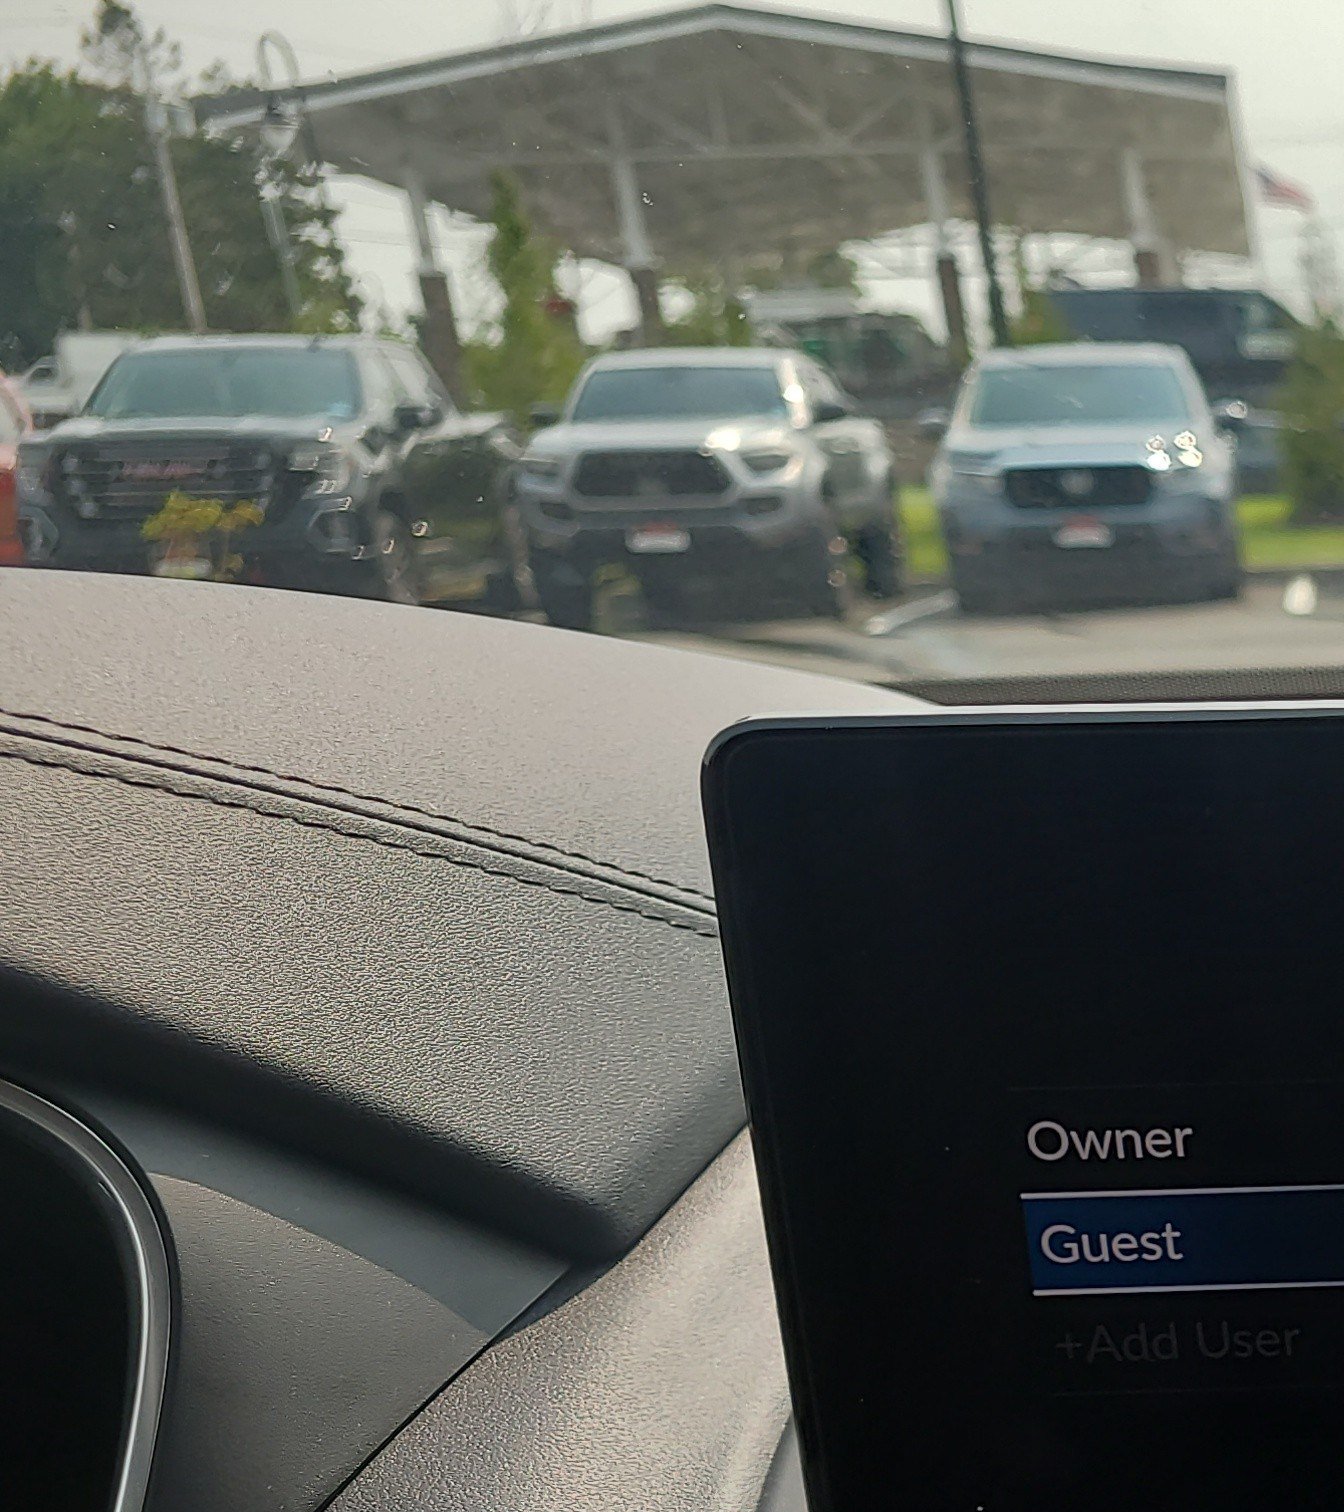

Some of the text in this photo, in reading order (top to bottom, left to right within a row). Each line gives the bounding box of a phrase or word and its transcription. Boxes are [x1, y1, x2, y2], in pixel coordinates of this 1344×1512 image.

[1028, 1121, 1193, 1160] Owner
[1041, 1223, 1183, 1263] Guest
[1196, 1320, 1301, 1359] User
